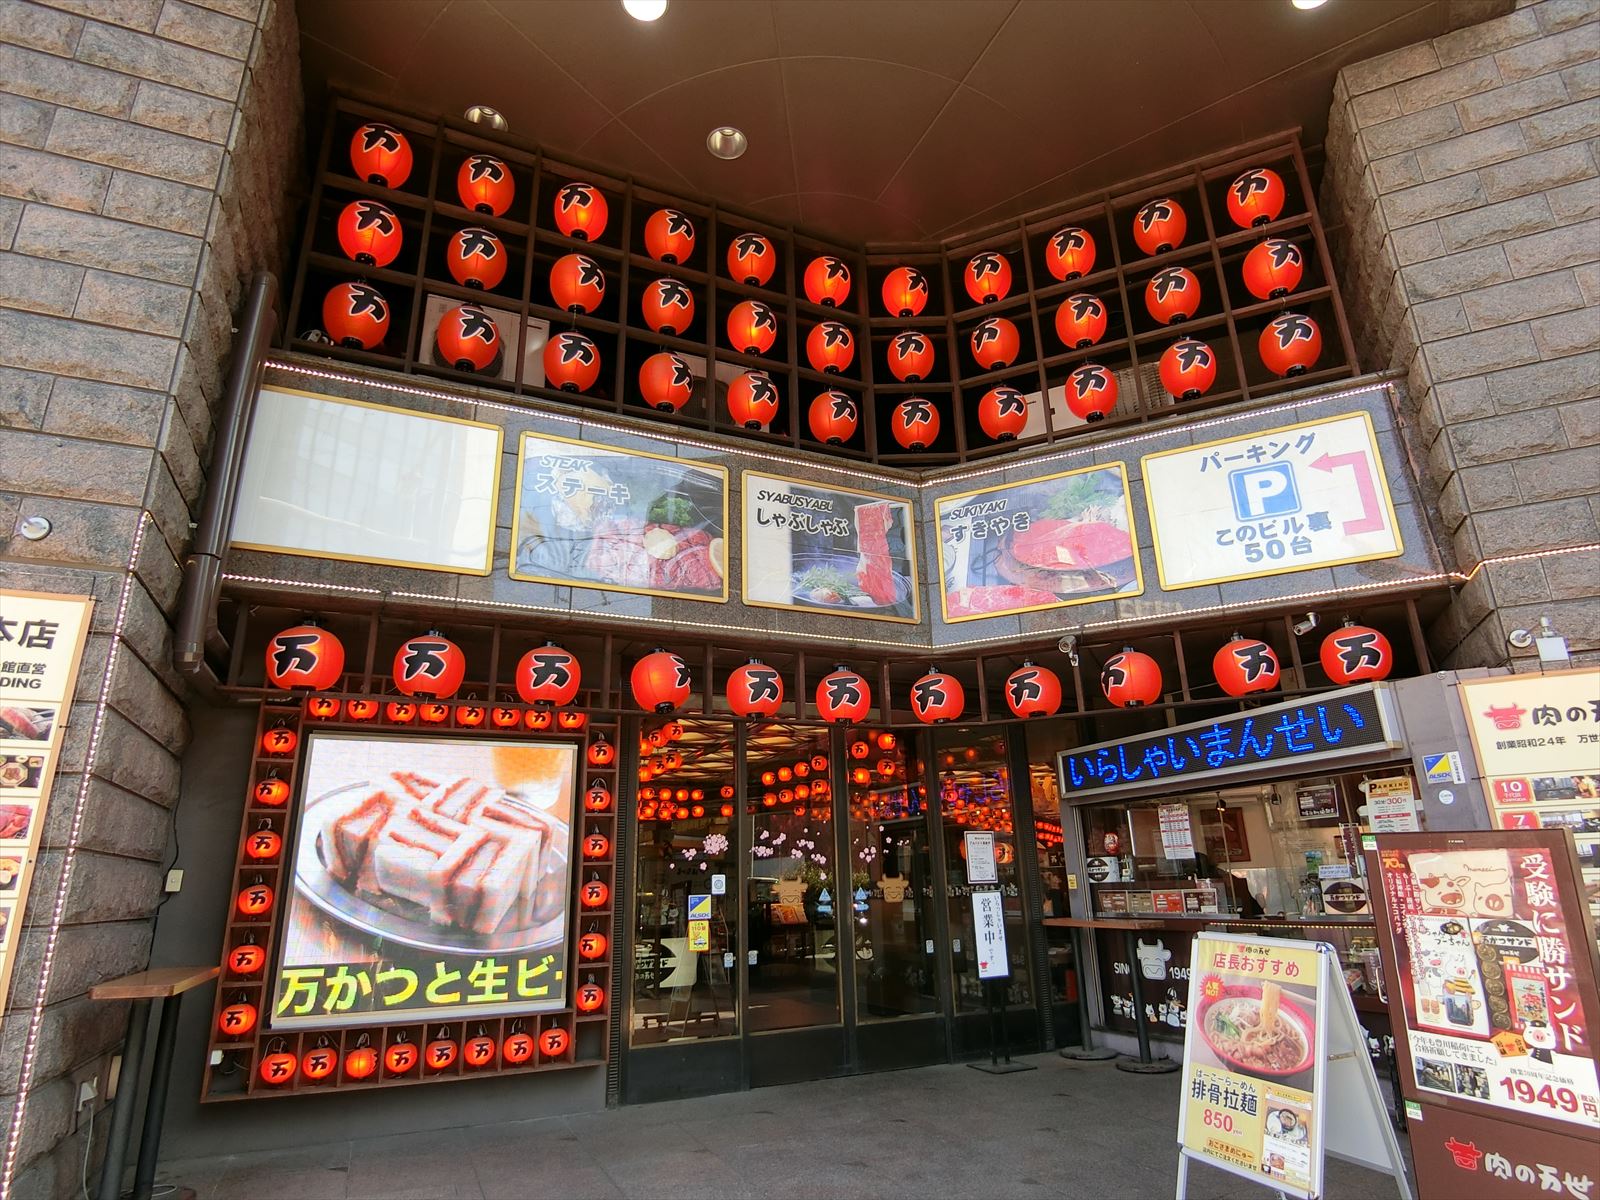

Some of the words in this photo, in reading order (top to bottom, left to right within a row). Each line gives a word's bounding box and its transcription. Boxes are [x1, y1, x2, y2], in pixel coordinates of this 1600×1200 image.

[362, 123, 401, 153] 万
[469, 155, 504, 183] 万
[560, 183, 594, 213] 万
[1233, 169, 1269, 205] 万
[355, 201, 394, 236] 万
[665, 209, 695, 240] 万
[1139, 199, 1172, 232] 万
[459, 228, 497, 260] 万
[736, 233, 766, 261] 万
[1054, 228, 1085, 258] 万
[1268, 239, 1300, 269] 万
[577, 255, 605, 292] 万
[824, 257, 850, 283] 万
[970, 252, 1002, 280] 万
[658, 279, 690, 309] 万
[905, 268, 928, 295] 万
[1153, 267, 1187, 302] 万
[349, 283, 386, 322] 万
[751, 301, 776, 333] 万
[1070, 295, 1101, 323] 万
[459, 308, 495, 344] 万
[821, 322, 850, 348] 万
[973, 318, 1000, 352] 万
[1274, 315, 1314, 349] 万
[559, 332, 595, 365] 万
[896, 332, 925, 360] 万
[1177, 342, 1210, 372] 万
[670, 355, 693, 391] 万
[1074, 366, 1107, 399] 万
[749, 374, 777, 406] 万
[996, 389, 1024, 417] 万
[829, 391, 856, 422] 万
[900, 399, 932, 428] 万
[540, 454, 594, 473] STEAK
[1200, 432, 1316, 473] パーキング
[535, 475, 631, 506] ステーキ
[756, 488, 835, 512] SYABUSYABU
[1244, 473, 1288, 515] P
[755, 507, 850, 537] しゃぶしゃぶ
[950, 499, 1008, 520] SUKIYAKI
[949, 511, 1032, 543] すきやき
[1216, 511, 1333, 547] このビル裏
[1244, 535, 1313, 563] 50台
[274, 634, 319, 678] 万
[403, 642, 449, 680] 万
[1234, 644, 1276, 683] 万
[1335, 633, 1381, 675] 万
[531, 654, 571, 689] 万
[746, 669, 780, 703] 万
[1101, 655, 1127, 698] 万
[826, 677, 861, 710] 万
[914, 677, 947, 713] 万
[1008, 670, 1043, 708] 万
[274, 731, 289, 745] 万
[595, 745, 608, 757] 万
[1496, 736, 1567, 750] 創業昭和24年
[259, 782, 275, 796] 万
[592, 791, 603, 804] 万
[1369, 782, 1409, 793] PARKING
[1501, 781, 1522, 793] 10
[1512, 814, 1527, 826] 7
[255, 836, 272, 850] 万
[590, 839, 603, 851] 万
[249, 890, 266, 906] 万
[587, 886, 601, 899] 万
[981, 898, 995, 944] 営業中
[236, 952, 253, 966] 万
[581, 938, 594, 952] 万
[1113, 962, 1131, 975] SIN
[1213, 952, 1299, 978] 店長おすすめ
[276, 955, 562, 1018] 万かつと生ビ
[583, 989, 597, 1003] 万
[226, 1011, 243, 1026] 万
[435, 1046, 451, 1062] 万
[475, 1042, 489, 1058] 万
[513, 1040, 528, 1056] 万
[547, 1034, 561, 1050] 万
[271, 1061, 289, 1077] 万
[311, 1055, 327, 1072] 万
[395, 1050, 410, 1067] 万
[1500, 1077, 1578, 1113] 1949
[1583, 1103, 1598, 1117] 円
[1203, 1108, 1233, 1133] 850
[1485, 1153, 1594, 1200] 肉の万世
